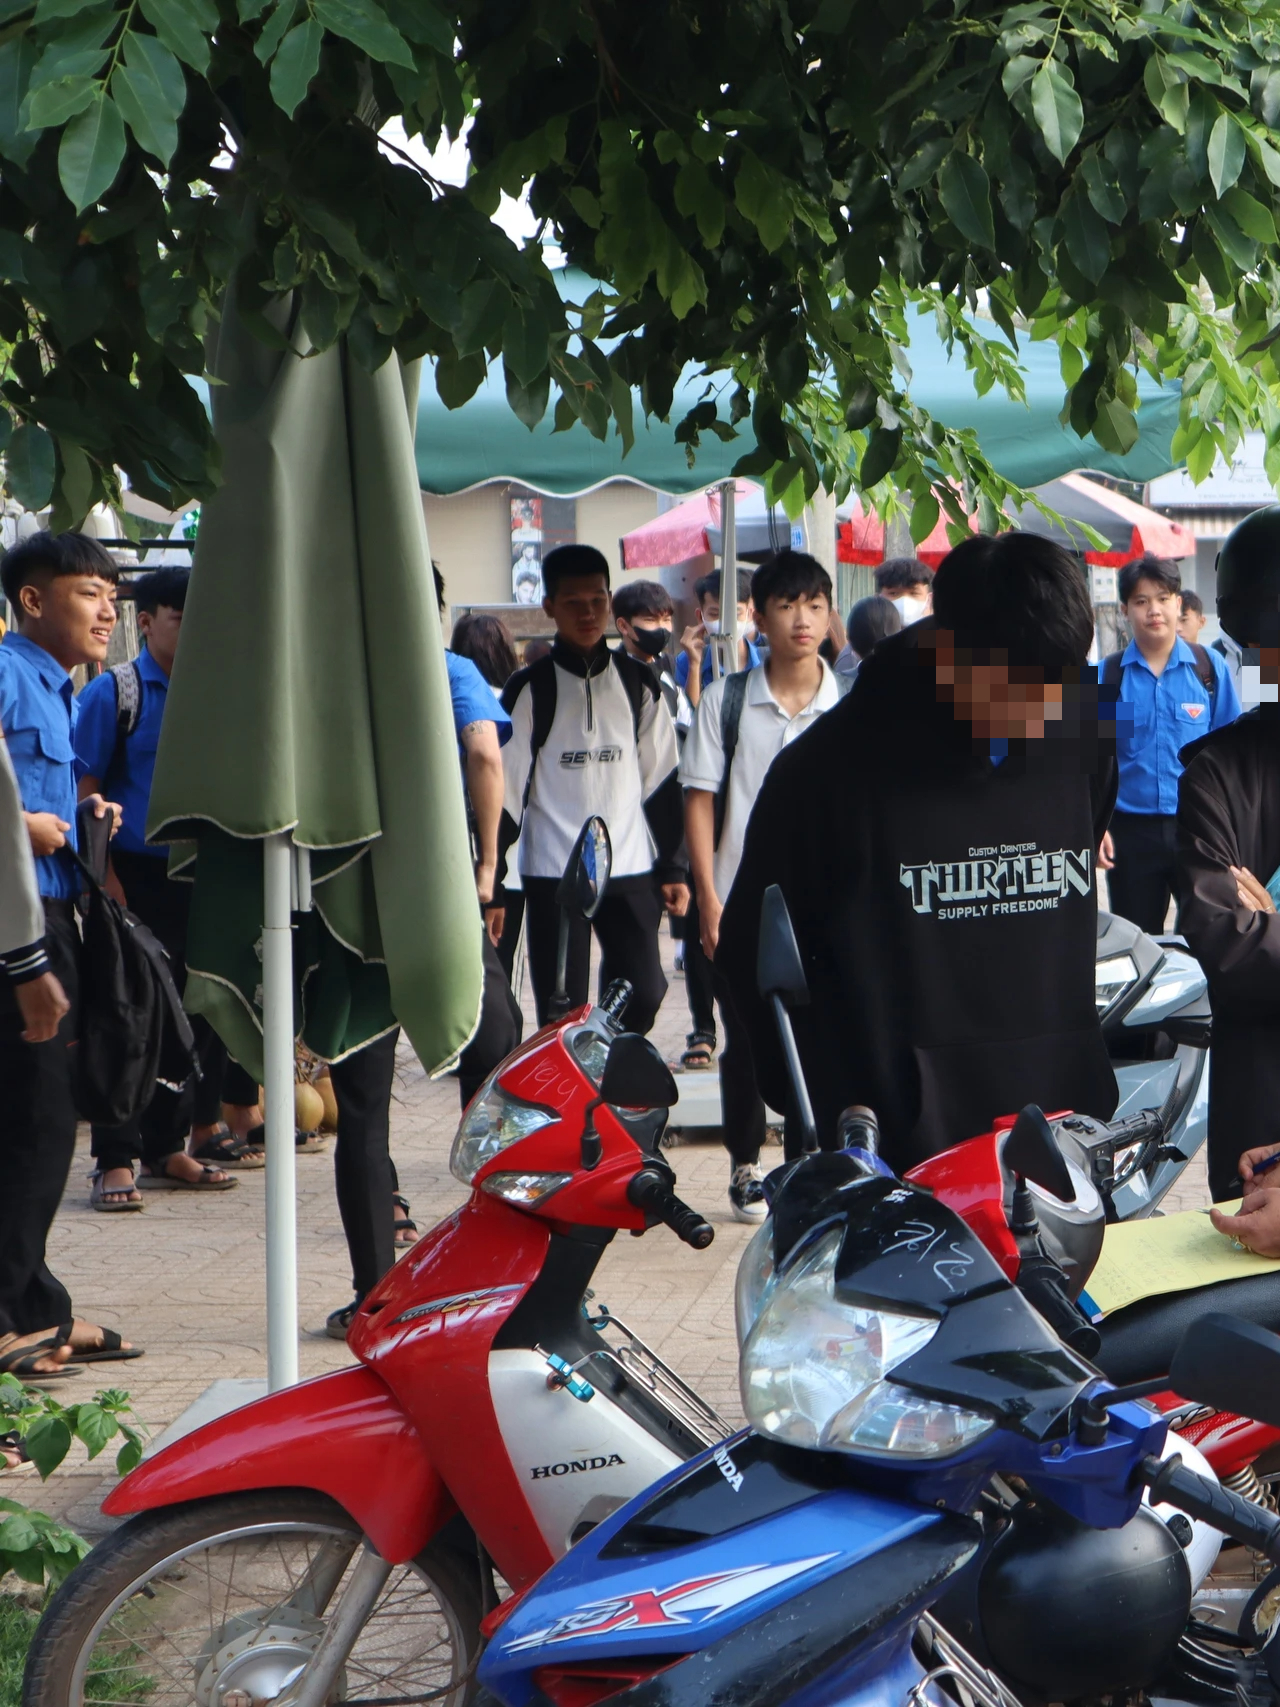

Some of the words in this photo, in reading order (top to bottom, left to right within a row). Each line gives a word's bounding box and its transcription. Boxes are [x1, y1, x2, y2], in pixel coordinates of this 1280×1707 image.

[899, 848, 1091, 914] THIRTEEN
[937, 904, 988, 920] SUPPLY
[992, 896, 1059, 915] FREEDOME
[530, 1452, 626, 1481] HONDA
